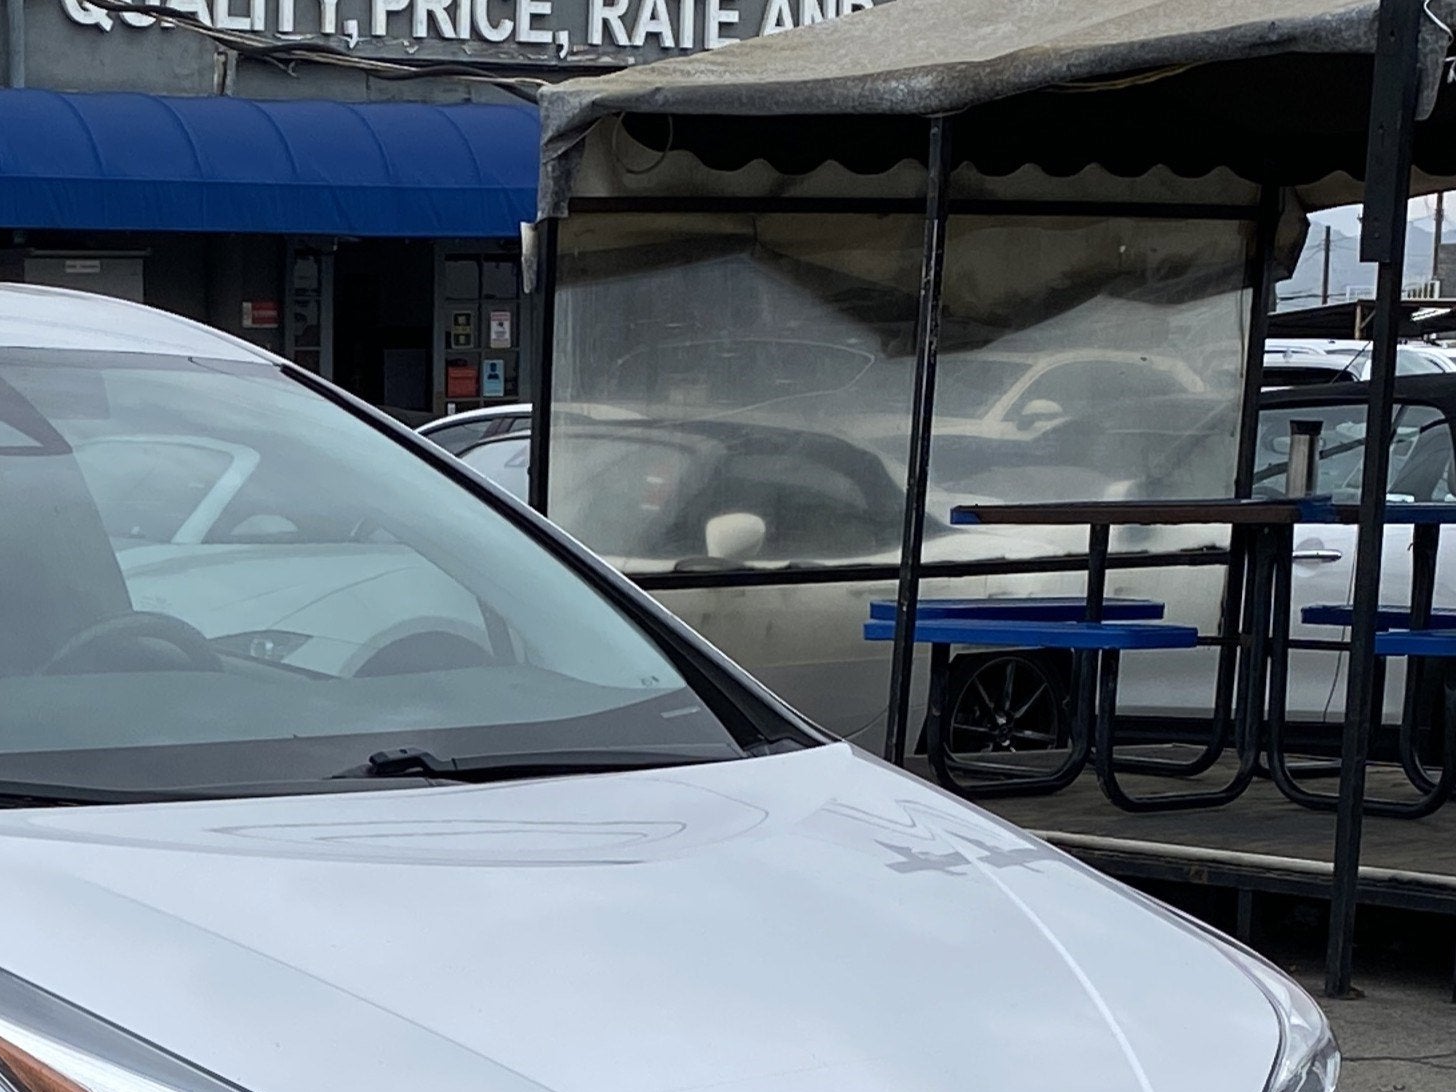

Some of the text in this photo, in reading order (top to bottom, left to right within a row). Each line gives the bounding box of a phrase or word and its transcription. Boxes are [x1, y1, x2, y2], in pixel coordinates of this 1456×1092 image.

[66, 0, 359, 50] QLITY,
[588, 0, 741, 50] RATE
[759, 0, 875, 37] AN
